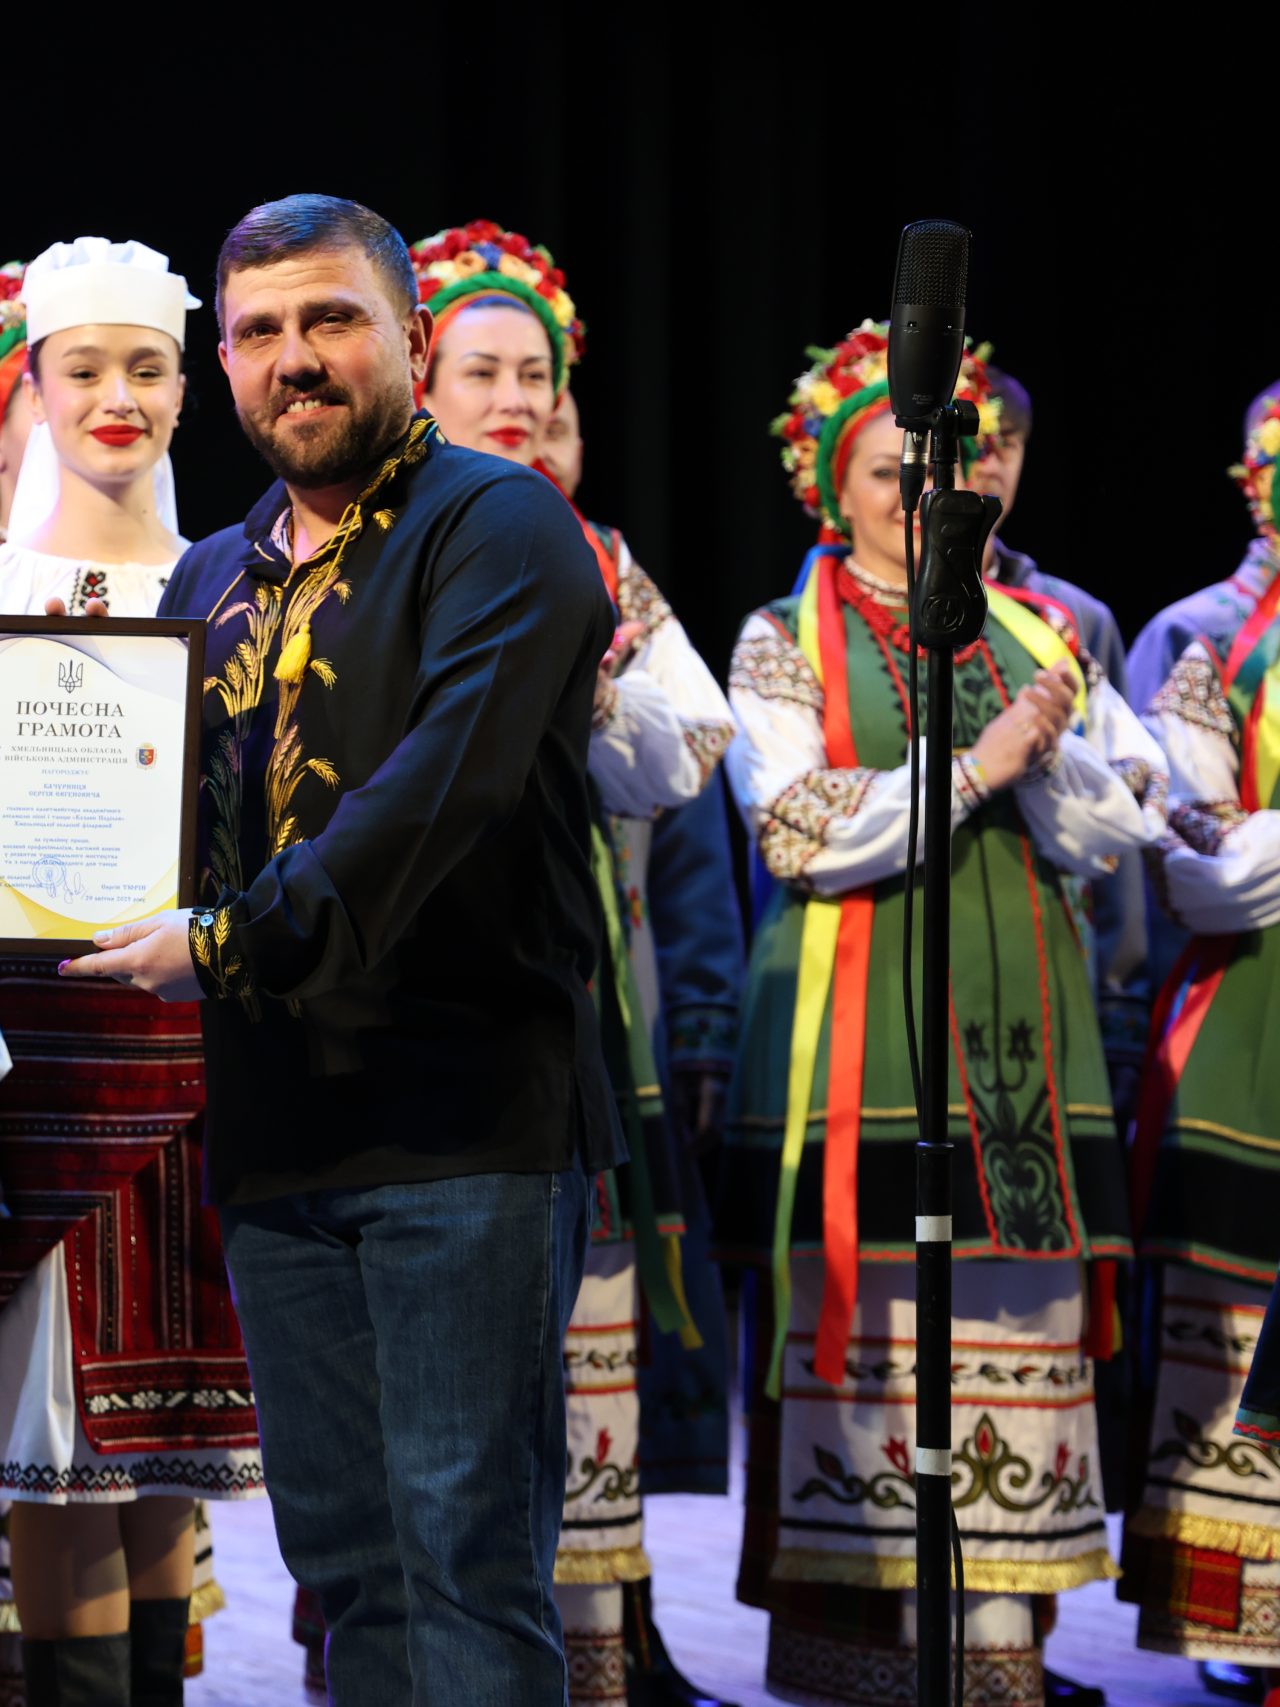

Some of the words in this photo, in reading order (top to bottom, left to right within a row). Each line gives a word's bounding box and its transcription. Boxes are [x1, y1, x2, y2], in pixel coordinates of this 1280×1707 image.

[16, 701, 124, 717] ПОЧЕСНА
[17, 722, 122, 738] ГРАМОТА
[10, 745, 78, 754] ХМЕЛЬНИЦЬКА
[80, 746, 122, 754] ОБЛАСНА
[4, 754, 55, 763] ВІЙСЬКОВА
[57, 756, 128, 764] АДМІНІСТРАЦІЯ
